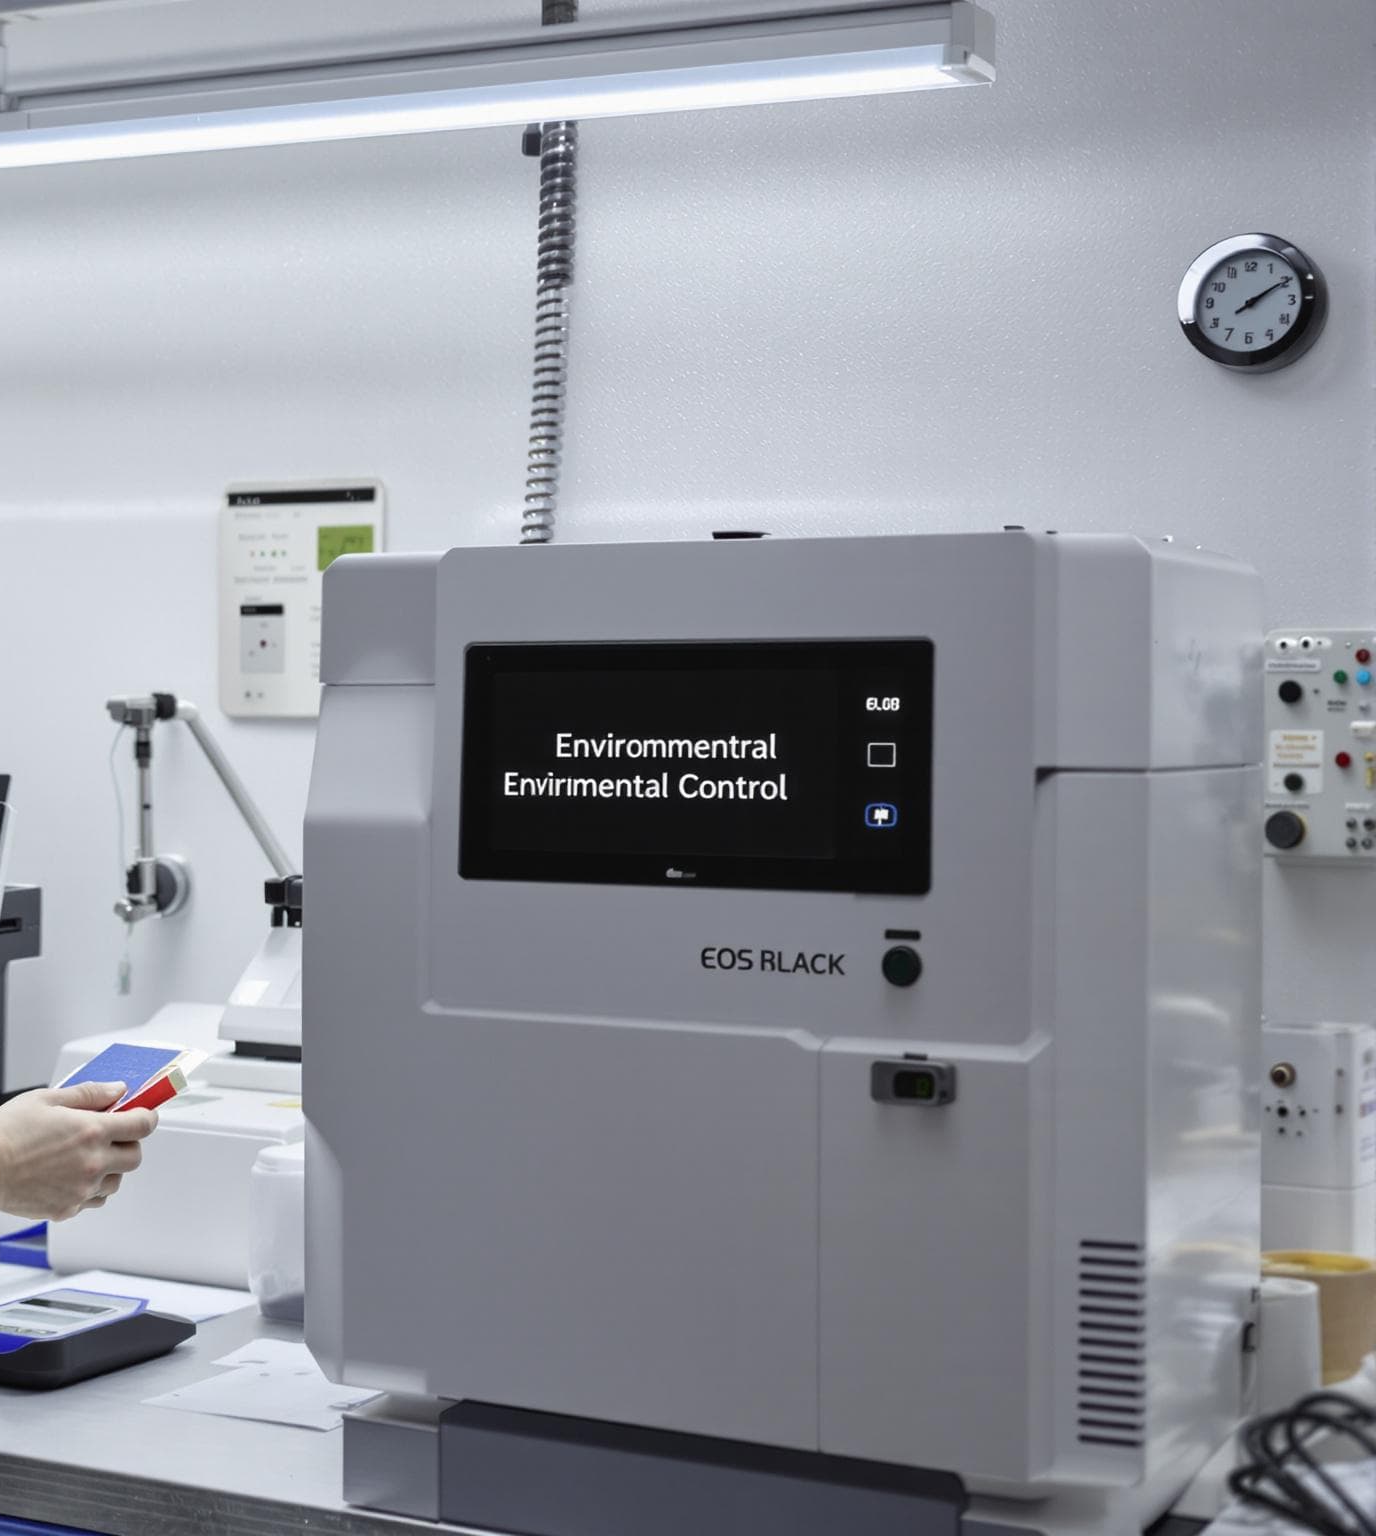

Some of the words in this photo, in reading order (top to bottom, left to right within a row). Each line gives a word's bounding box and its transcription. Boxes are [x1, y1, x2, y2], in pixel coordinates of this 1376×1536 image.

[1287, 294, 1296, 305] 3
[1225, 328, 1235, 341] 7
[556, 732, 777, 760] Envirommentral
[678, 773, 788, 801] Control
[700, 947, 753, 970] EOS
